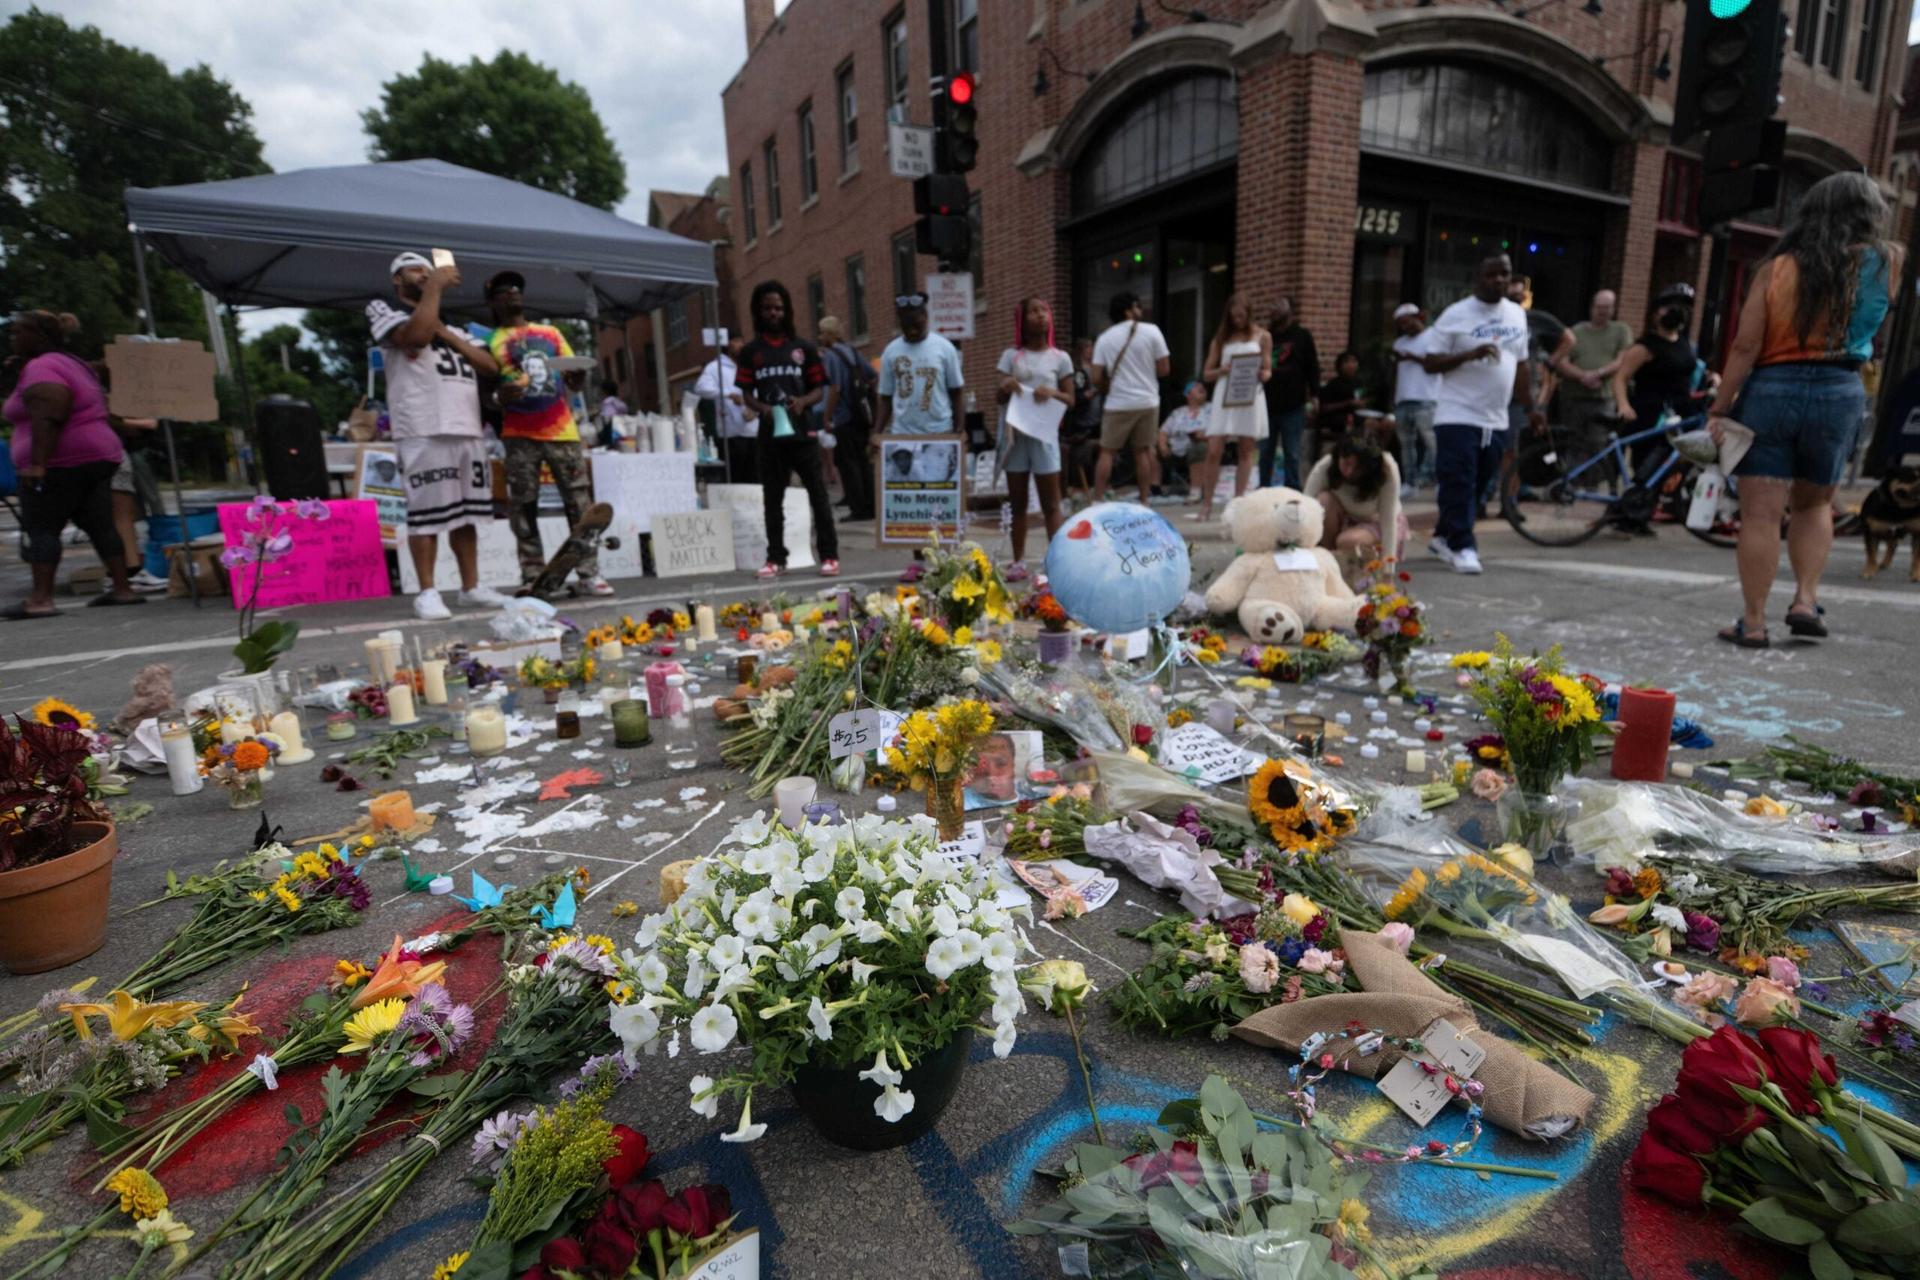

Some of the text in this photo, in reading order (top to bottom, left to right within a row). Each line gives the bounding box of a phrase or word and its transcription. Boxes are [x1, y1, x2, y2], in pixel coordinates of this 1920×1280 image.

[904, 132, 919, 145] NO
[902, 146, 923, 158] TURN
[1354, 206, 1401, 235] 1255
[895, 354, 940, 412] 67
[893, 493, 949, 504] No More
[663, 515, 716, 541] BLACK
[670, 546, 722, 570] MATTER
[831, 727, 869, 748] $25
